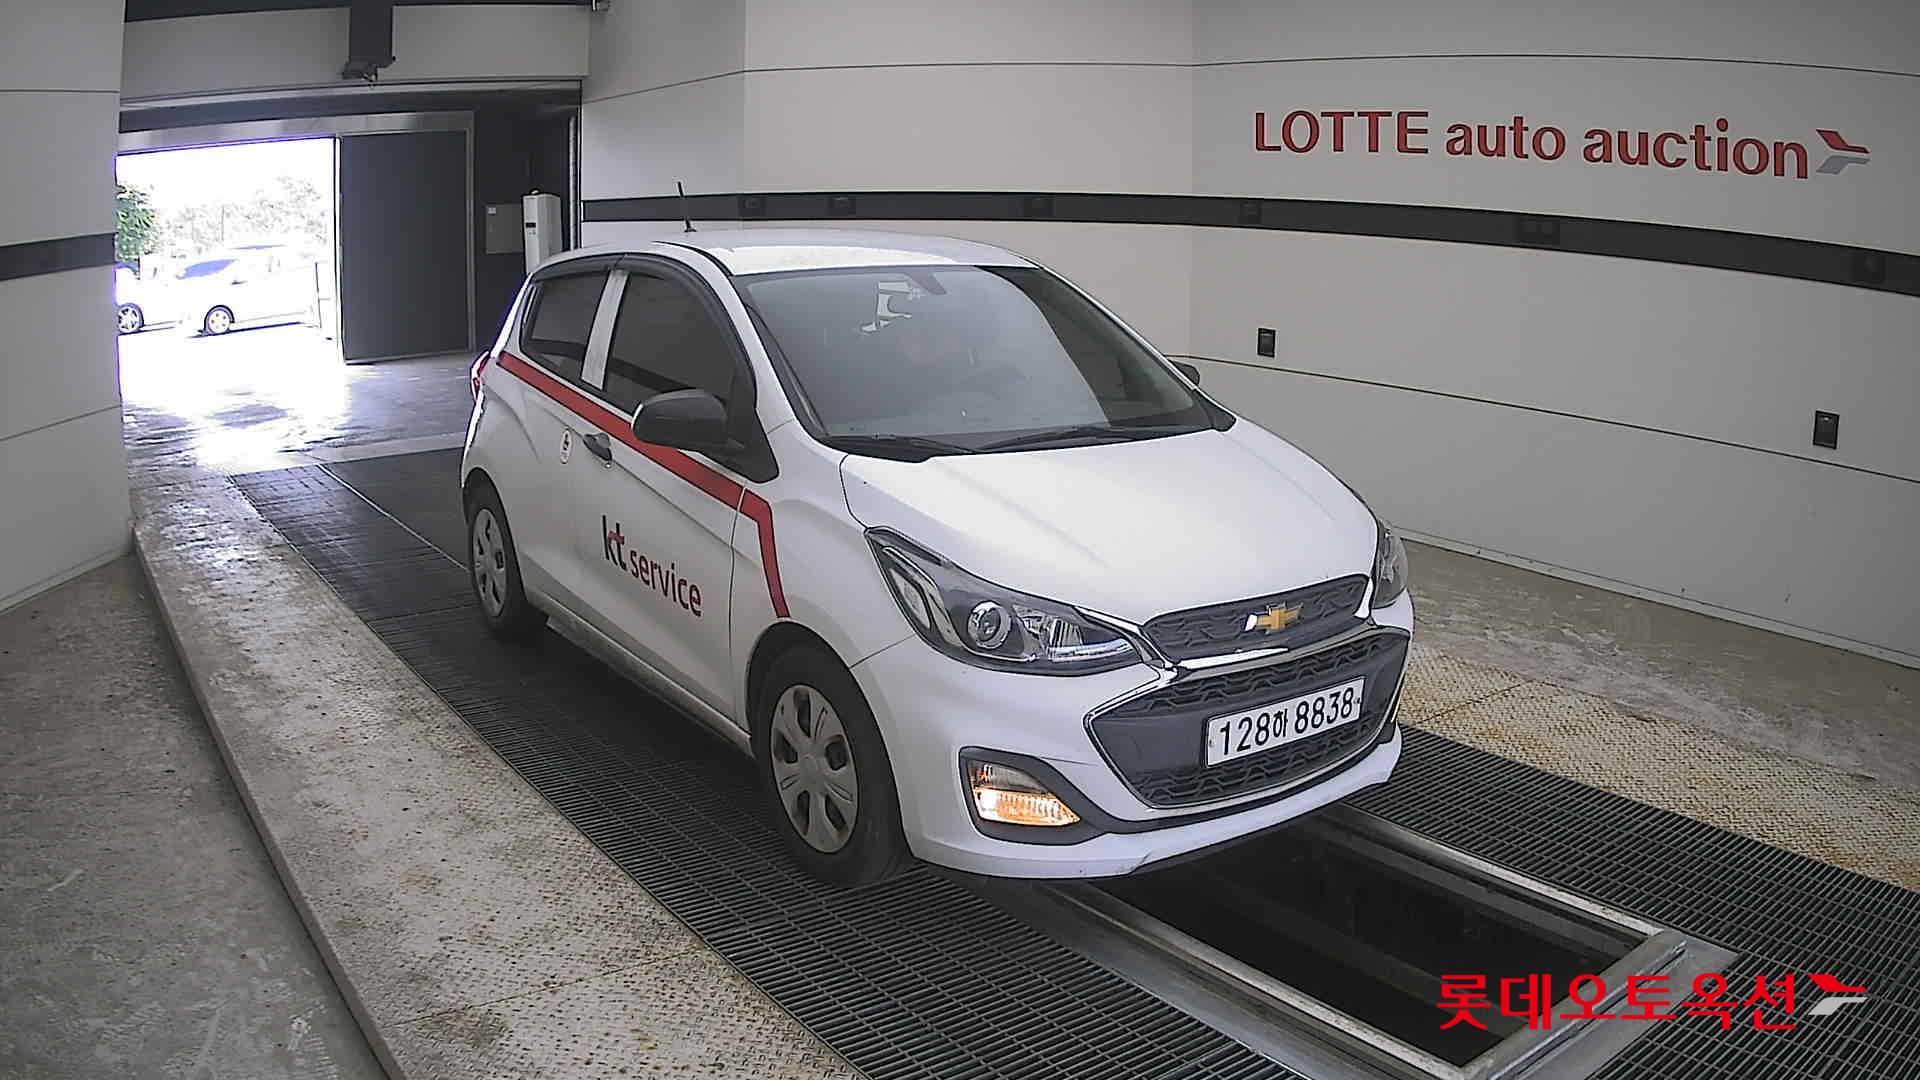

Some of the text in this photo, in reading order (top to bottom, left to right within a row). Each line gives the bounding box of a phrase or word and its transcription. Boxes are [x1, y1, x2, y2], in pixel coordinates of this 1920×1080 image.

[1255, 111, 1809, 180] LOTTE auto auction
[602, 514, 702, 617] kt service
[1220, 687, 1354, 756] 128하 8838
